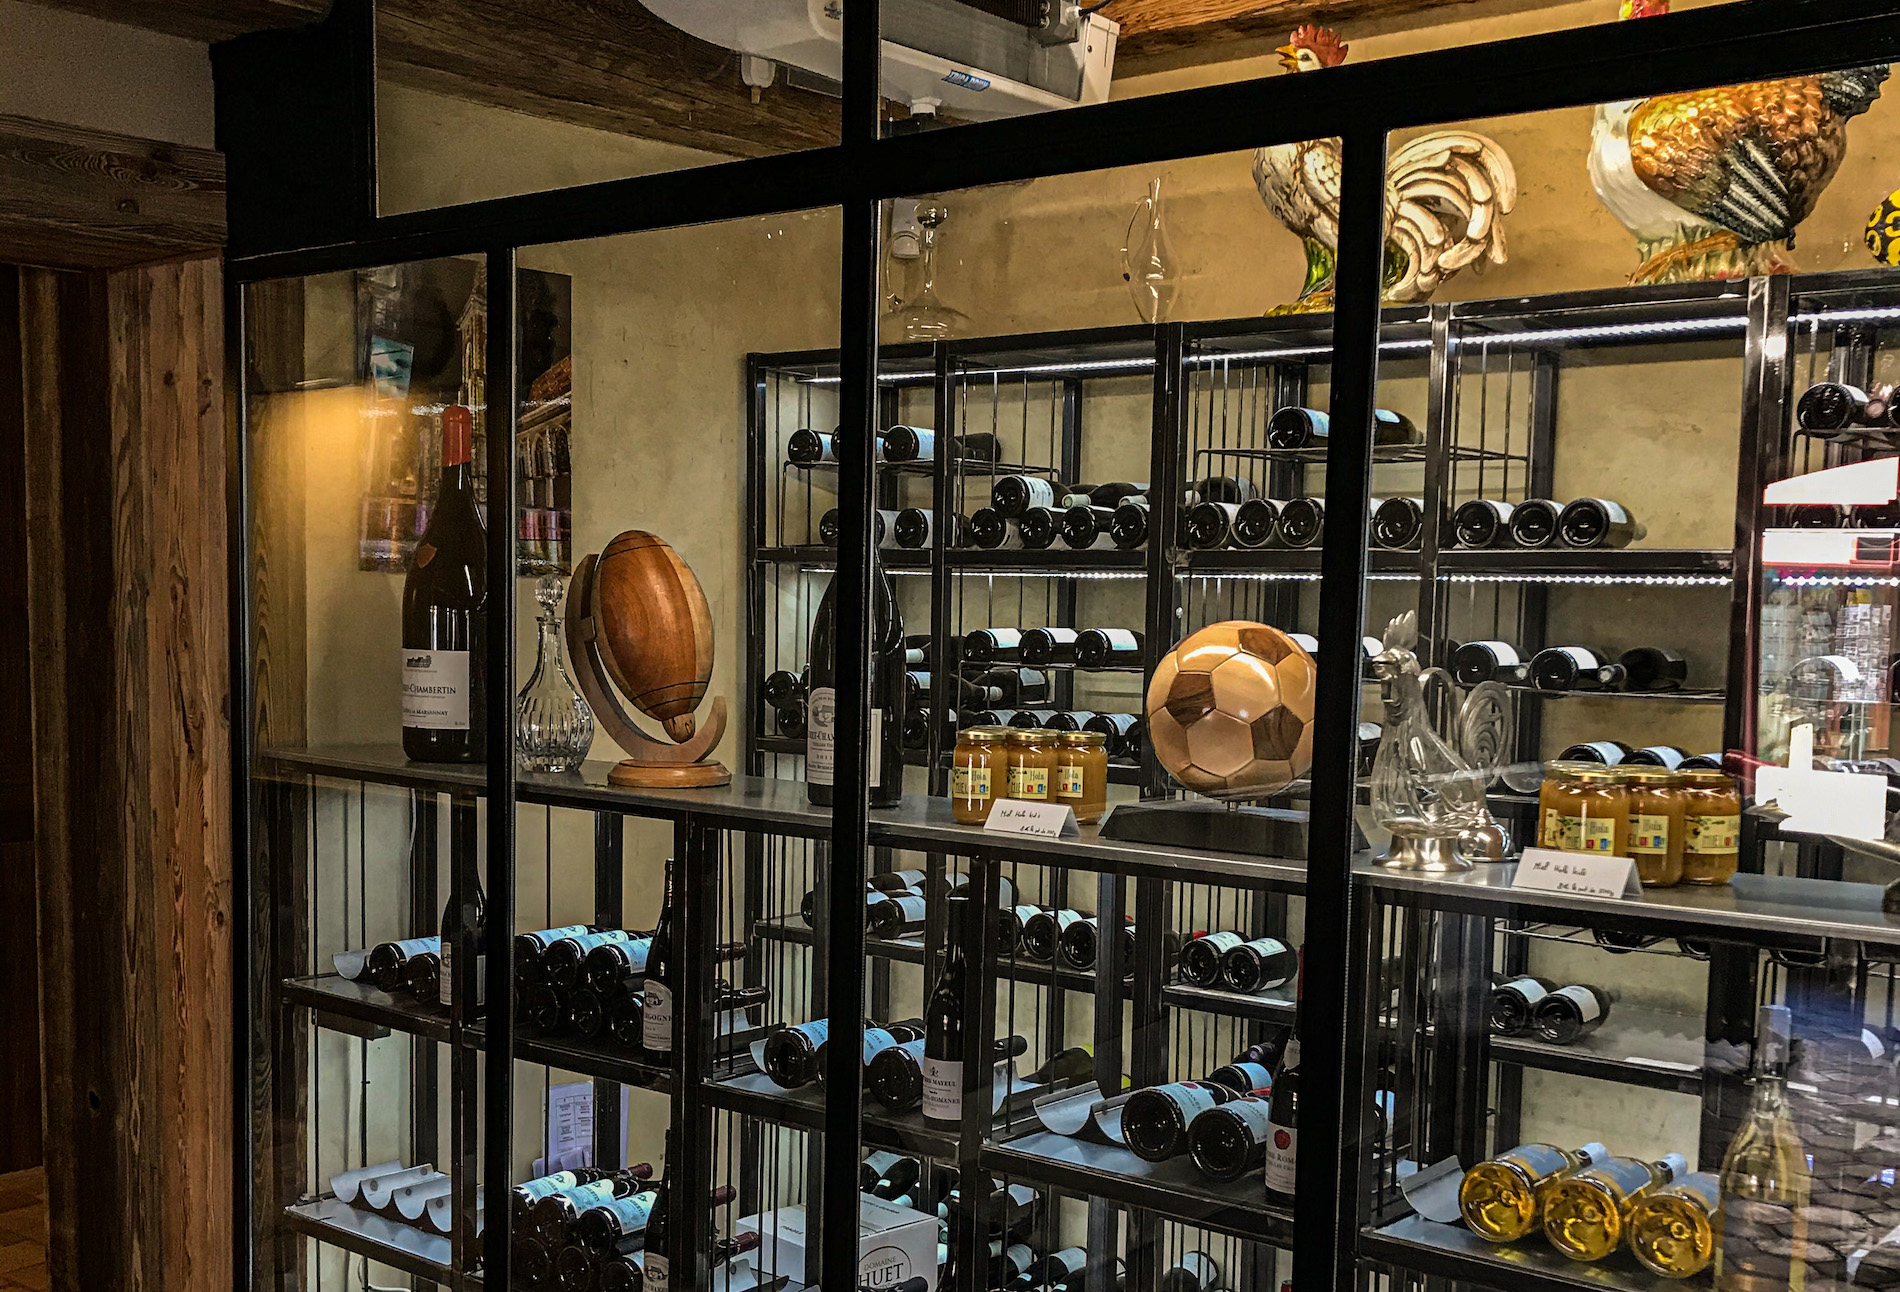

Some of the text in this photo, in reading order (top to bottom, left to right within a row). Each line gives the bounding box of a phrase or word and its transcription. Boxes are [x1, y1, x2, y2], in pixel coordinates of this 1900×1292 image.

[1030, 770, 1045, 781] Hola
[864, 1255, 897, 1271] DOMAINE
[859, 1263, 904, 1287] HUET
